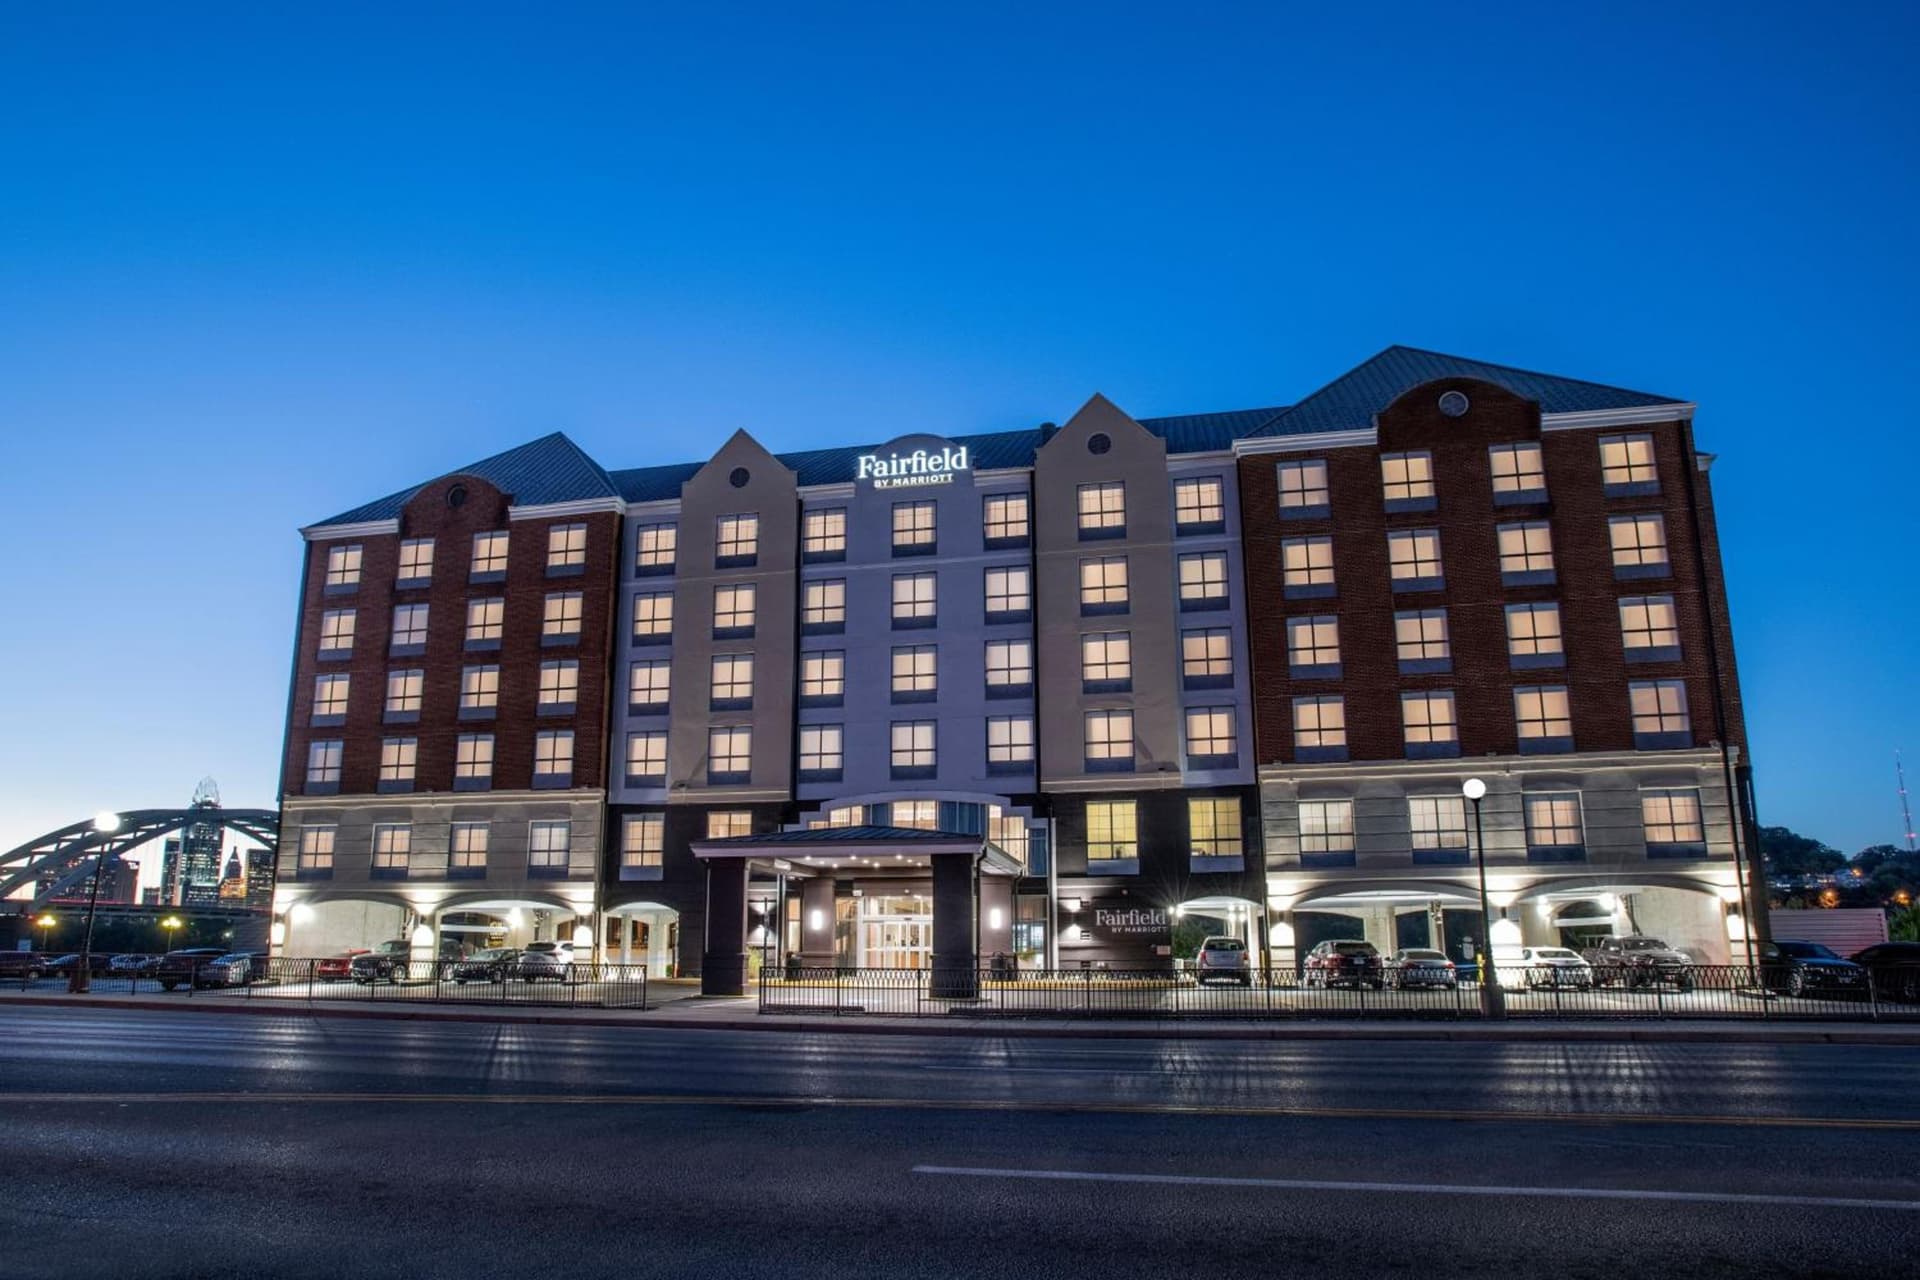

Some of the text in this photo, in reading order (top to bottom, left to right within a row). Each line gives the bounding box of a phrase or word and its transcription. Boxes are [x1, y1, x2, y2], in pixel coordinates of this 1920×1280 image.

[858, 446, 968, 479] Fairfield
[874, 473, 953, 488] BY MARRIOTT
[1095, 909, 1166, 926] Fairfield
